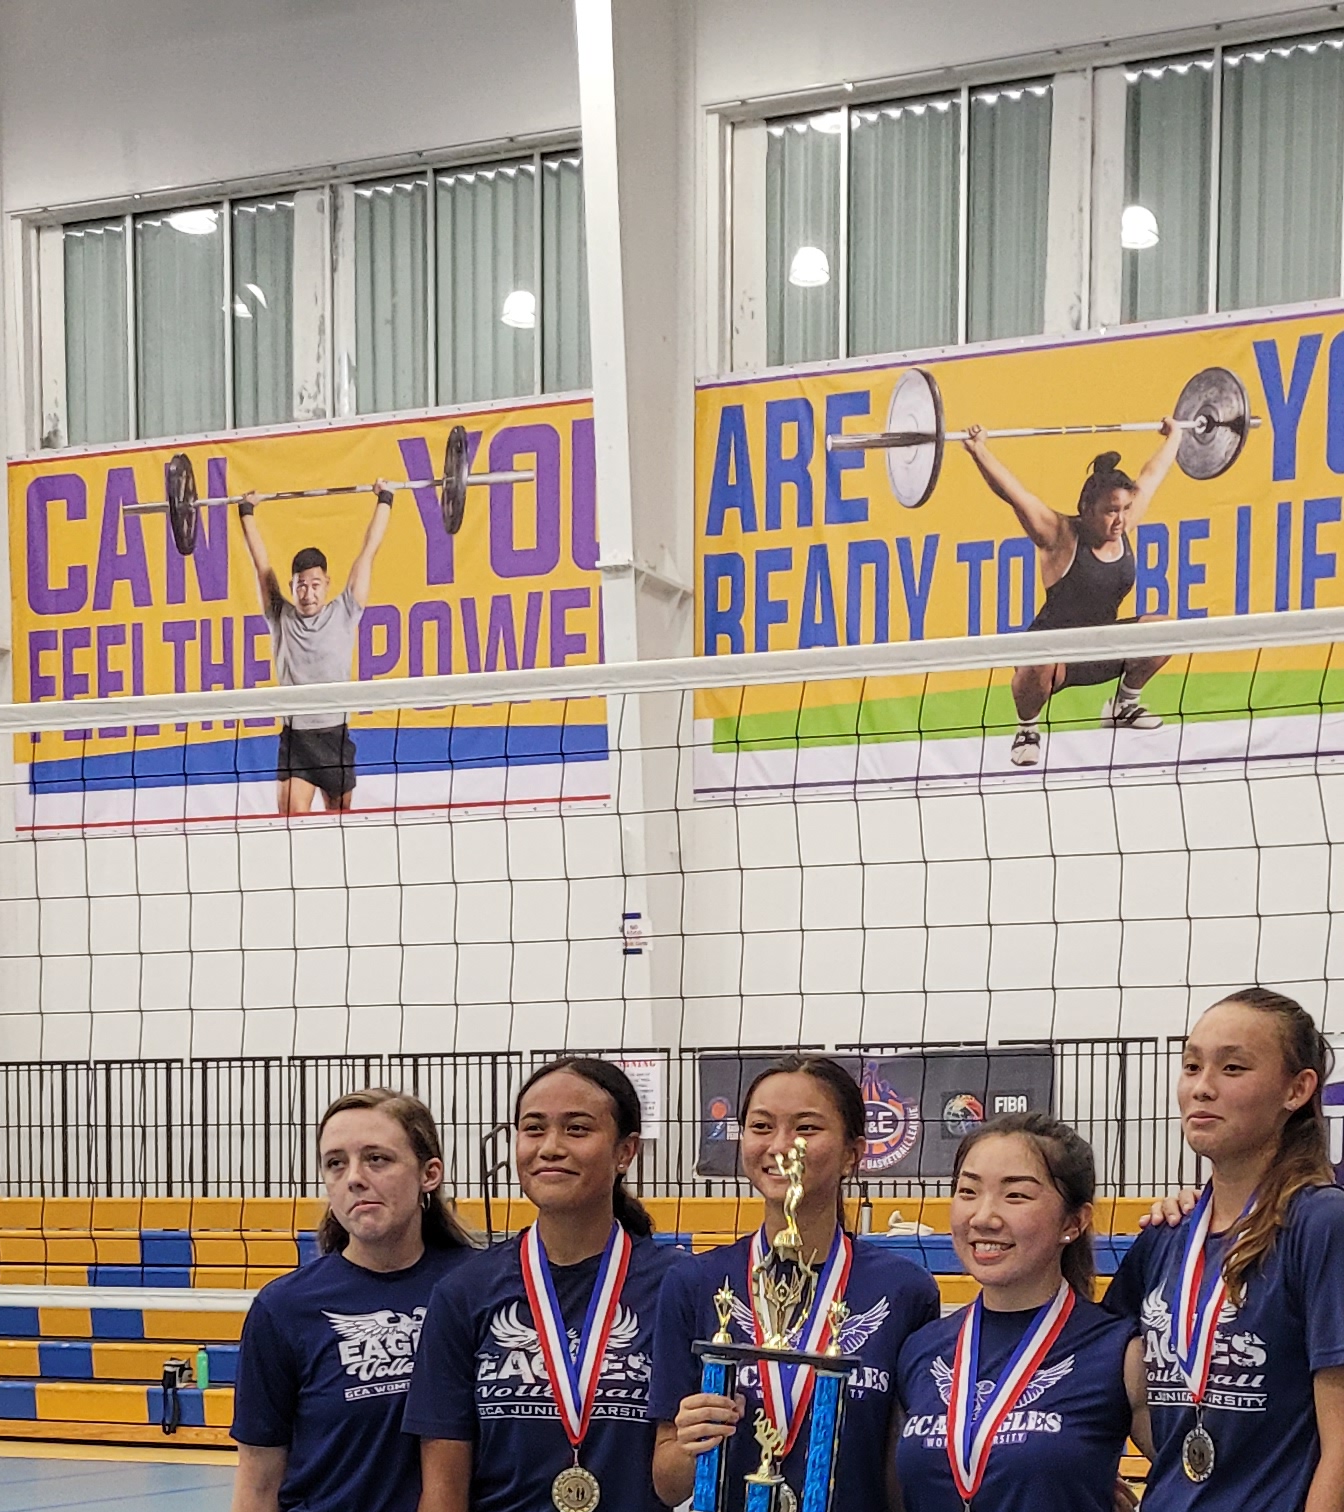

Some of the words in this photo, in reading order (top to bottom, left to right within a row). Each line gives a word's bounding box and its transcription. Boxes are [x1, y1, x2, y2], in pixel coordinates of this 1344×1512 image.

[705, 389, 870, 536] ARE
[27, 457, 229, 615] CAN
[957, 535, 1035, 636] TO
[1136, 516, 1209, 622] BE
[358, 586, 605, 714] POWE
[994, 1095, 1028, 1113] FIBA
[338, 1331, 421, 1366] EAG
[344, 1387, 371, 1399] GCA
[902, 1414, 947, 1438] GCA
